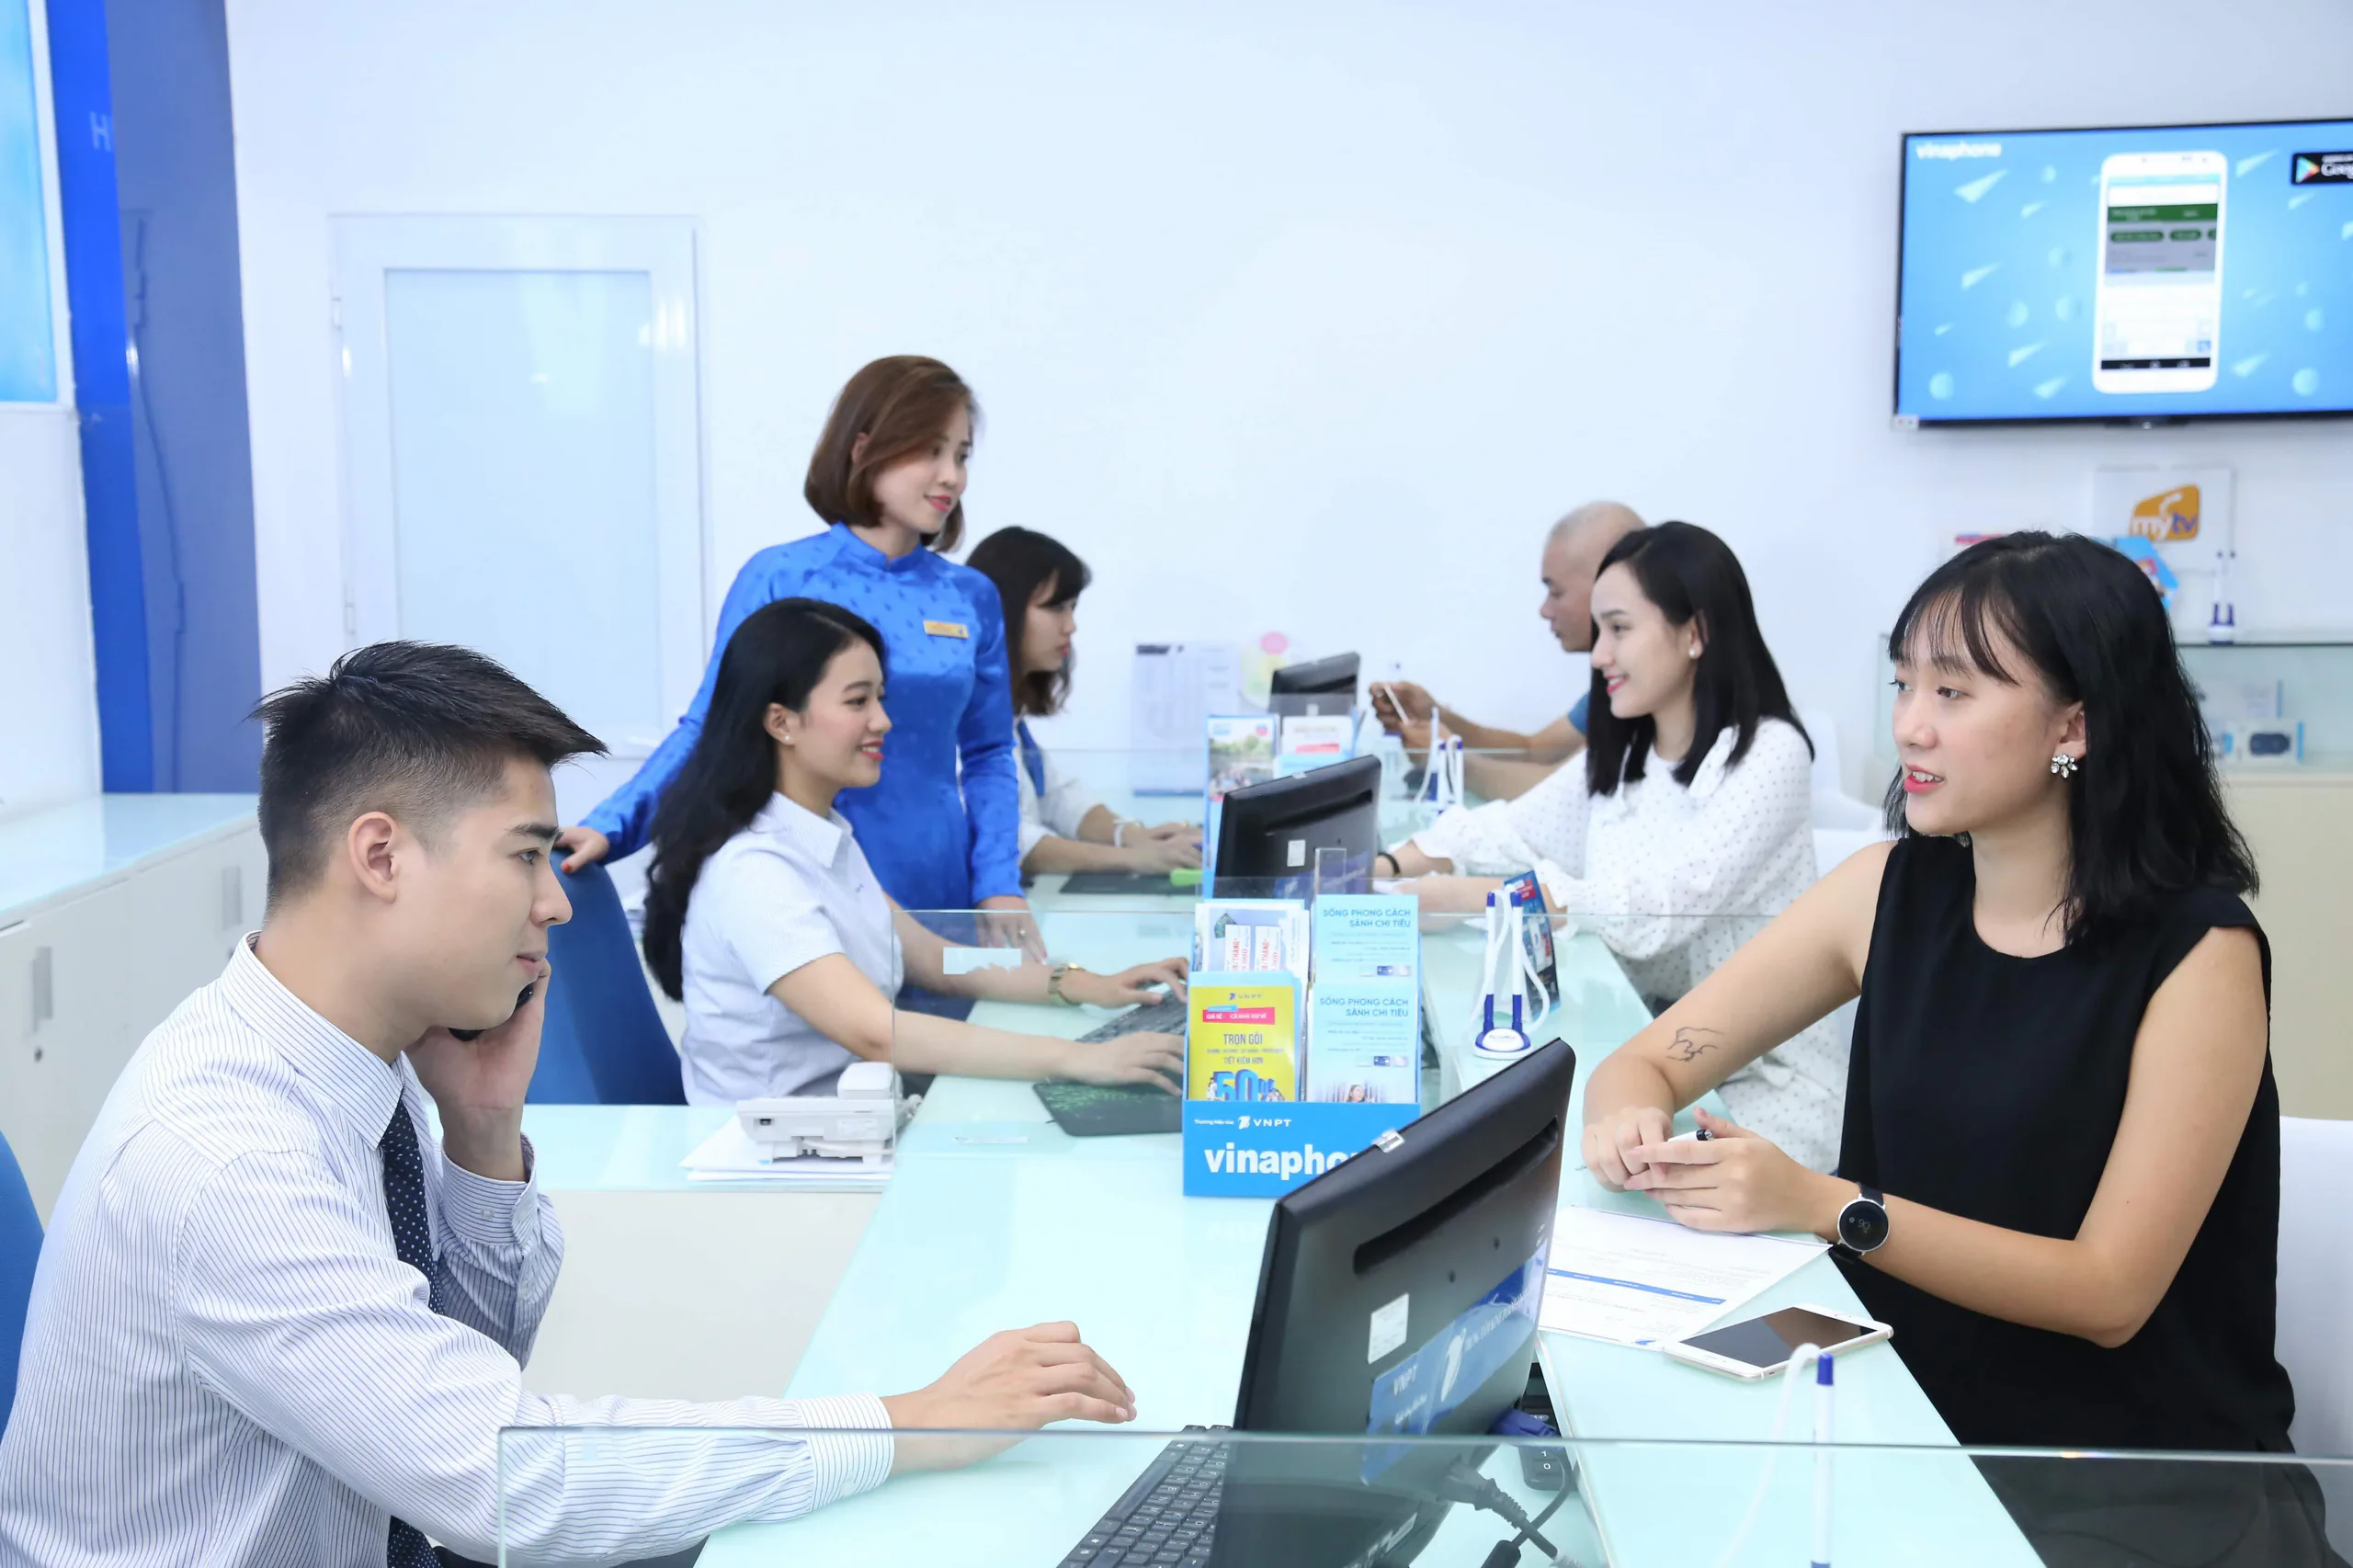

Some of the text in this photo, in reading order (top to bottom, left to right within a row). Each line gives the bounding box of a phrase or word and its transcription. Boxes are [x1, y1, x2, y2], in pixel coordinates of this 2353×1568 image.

[1351, 909, 1383, 917] PHONG
[1347, 998, 1381, 1006] PHONG
[1223, 1033, 1246, 1047] TRỌN
[1253, 1119, 1291, 1128] VNPT
[1204, 1142, 1358, 1181] vinapho
